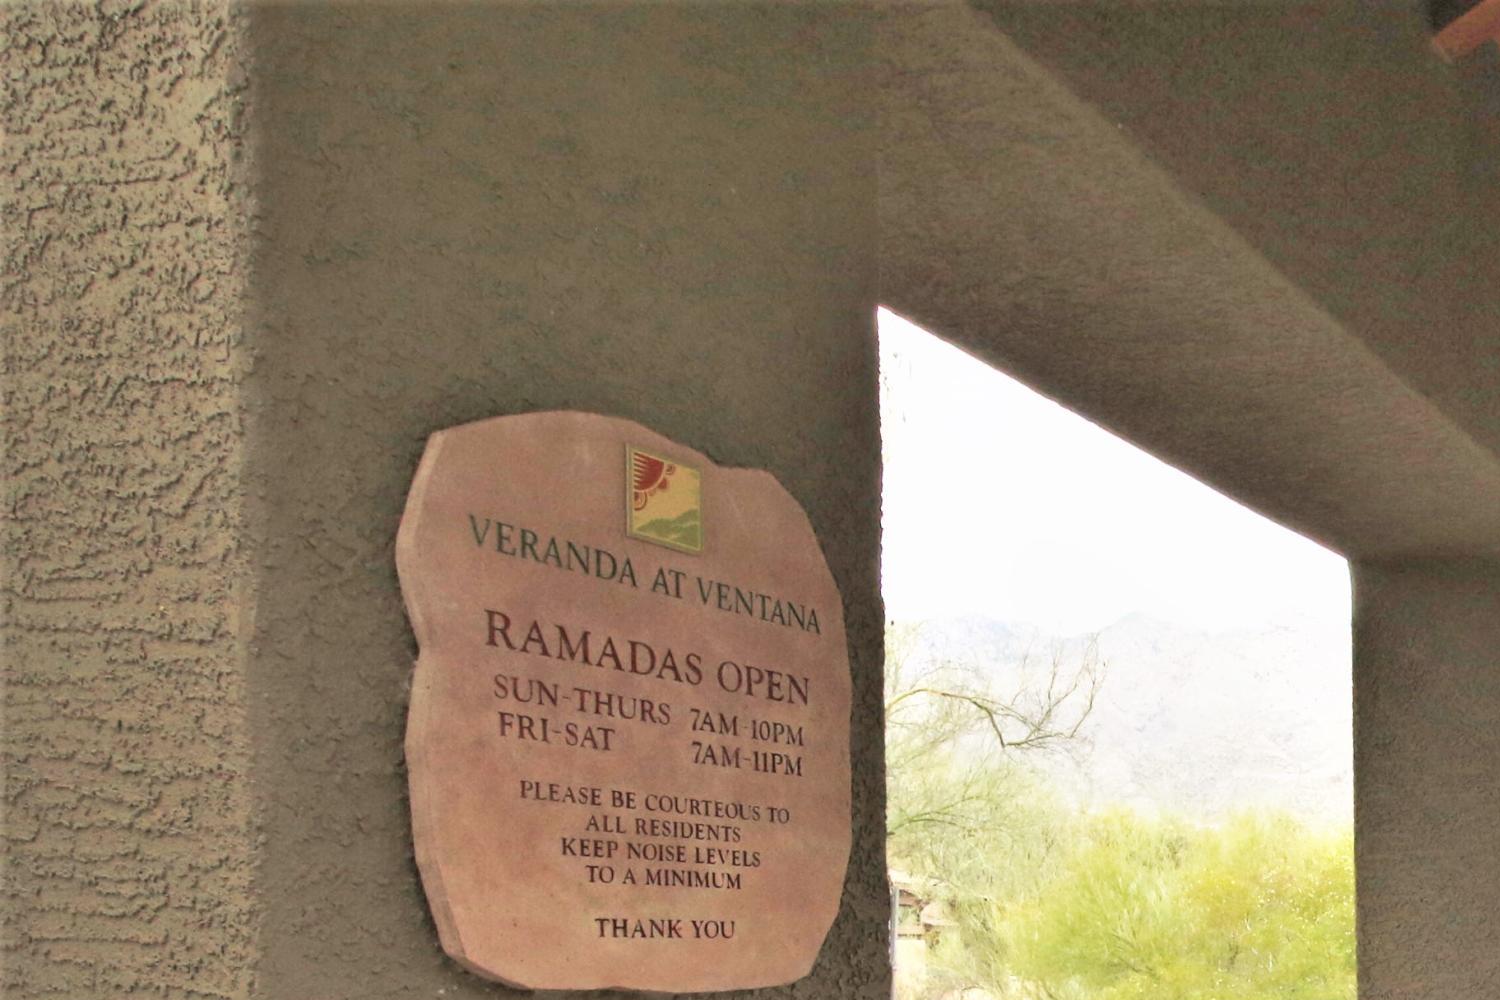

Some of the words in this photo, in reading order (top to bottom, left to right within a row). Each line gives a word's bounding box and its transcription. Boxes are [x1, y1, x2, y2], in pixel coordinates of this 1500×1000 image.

[469, 514, 638, 587] VERANDA
[652, 568, 685, 598] AT
[696, 577, 822, 635] VENTANA
[484, 609, 702, 686] RAMADAS
[717, 661, 810, 706] OPEN
[493, 674, 671, 726] SUN-THURS
[497, 711, 615, 751] FRI-SAT
[691, 741, 803, 777] 7AM-11PM
[520, 780, 601, 807] PLEASE
[611, 790, 637, 810] BE
[644, 794, 761, 822] COURTEOUS
[767, 805, 790, 824] TO
[585, 815, 627, 834] ALL
[635, 818, 741, 843] RESIDENTS
[561, 838, 619, 859] KEEP
[627, 842, 687, 863] NOISE
[694, 847, 761, 868] LEVELS
[585, 866, 614, 884] TO
[622, 869, 636, 886] A
[645, 871, 742, 890] MINIMUM
[595, 918, 683, 939] THANK
[691, 920, 735, 938] YOU
